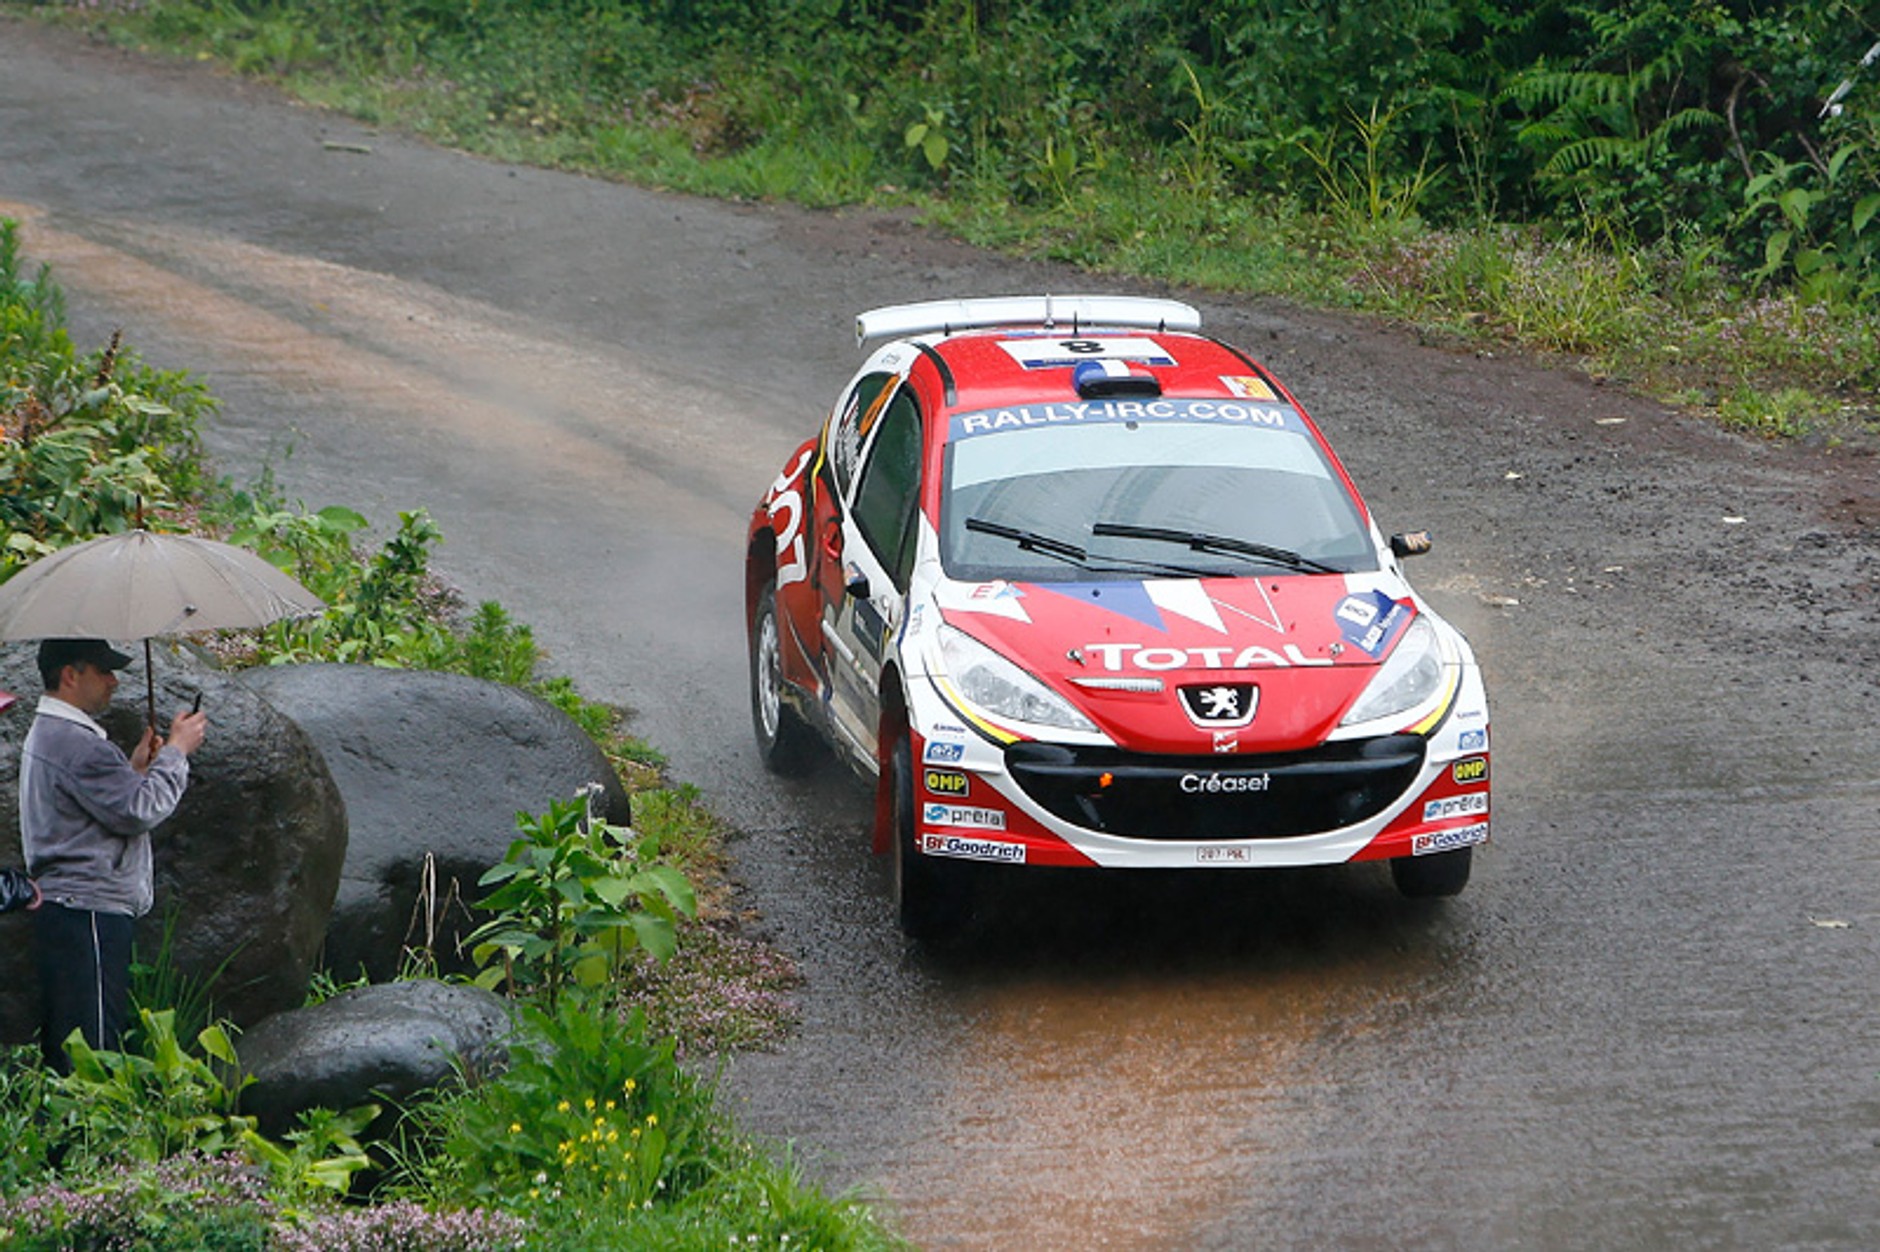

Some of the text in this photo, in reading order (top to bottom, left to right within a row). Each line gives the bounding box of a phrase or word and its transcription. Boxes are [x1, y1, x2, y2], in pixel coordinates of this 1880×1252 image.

[1059, 340, 1106, 354] 8
[962, 402, 1285, 434] RALLY-IRC.COM
[1085, 643, 1333, 671] TOTAL
[1456, 762, 1486, 780] OMP
[928, 773, 965, 791] OMP
[1180, 772, 1270, 793] Créaset
[925, 836, 1025, 859] BFGoodrich
